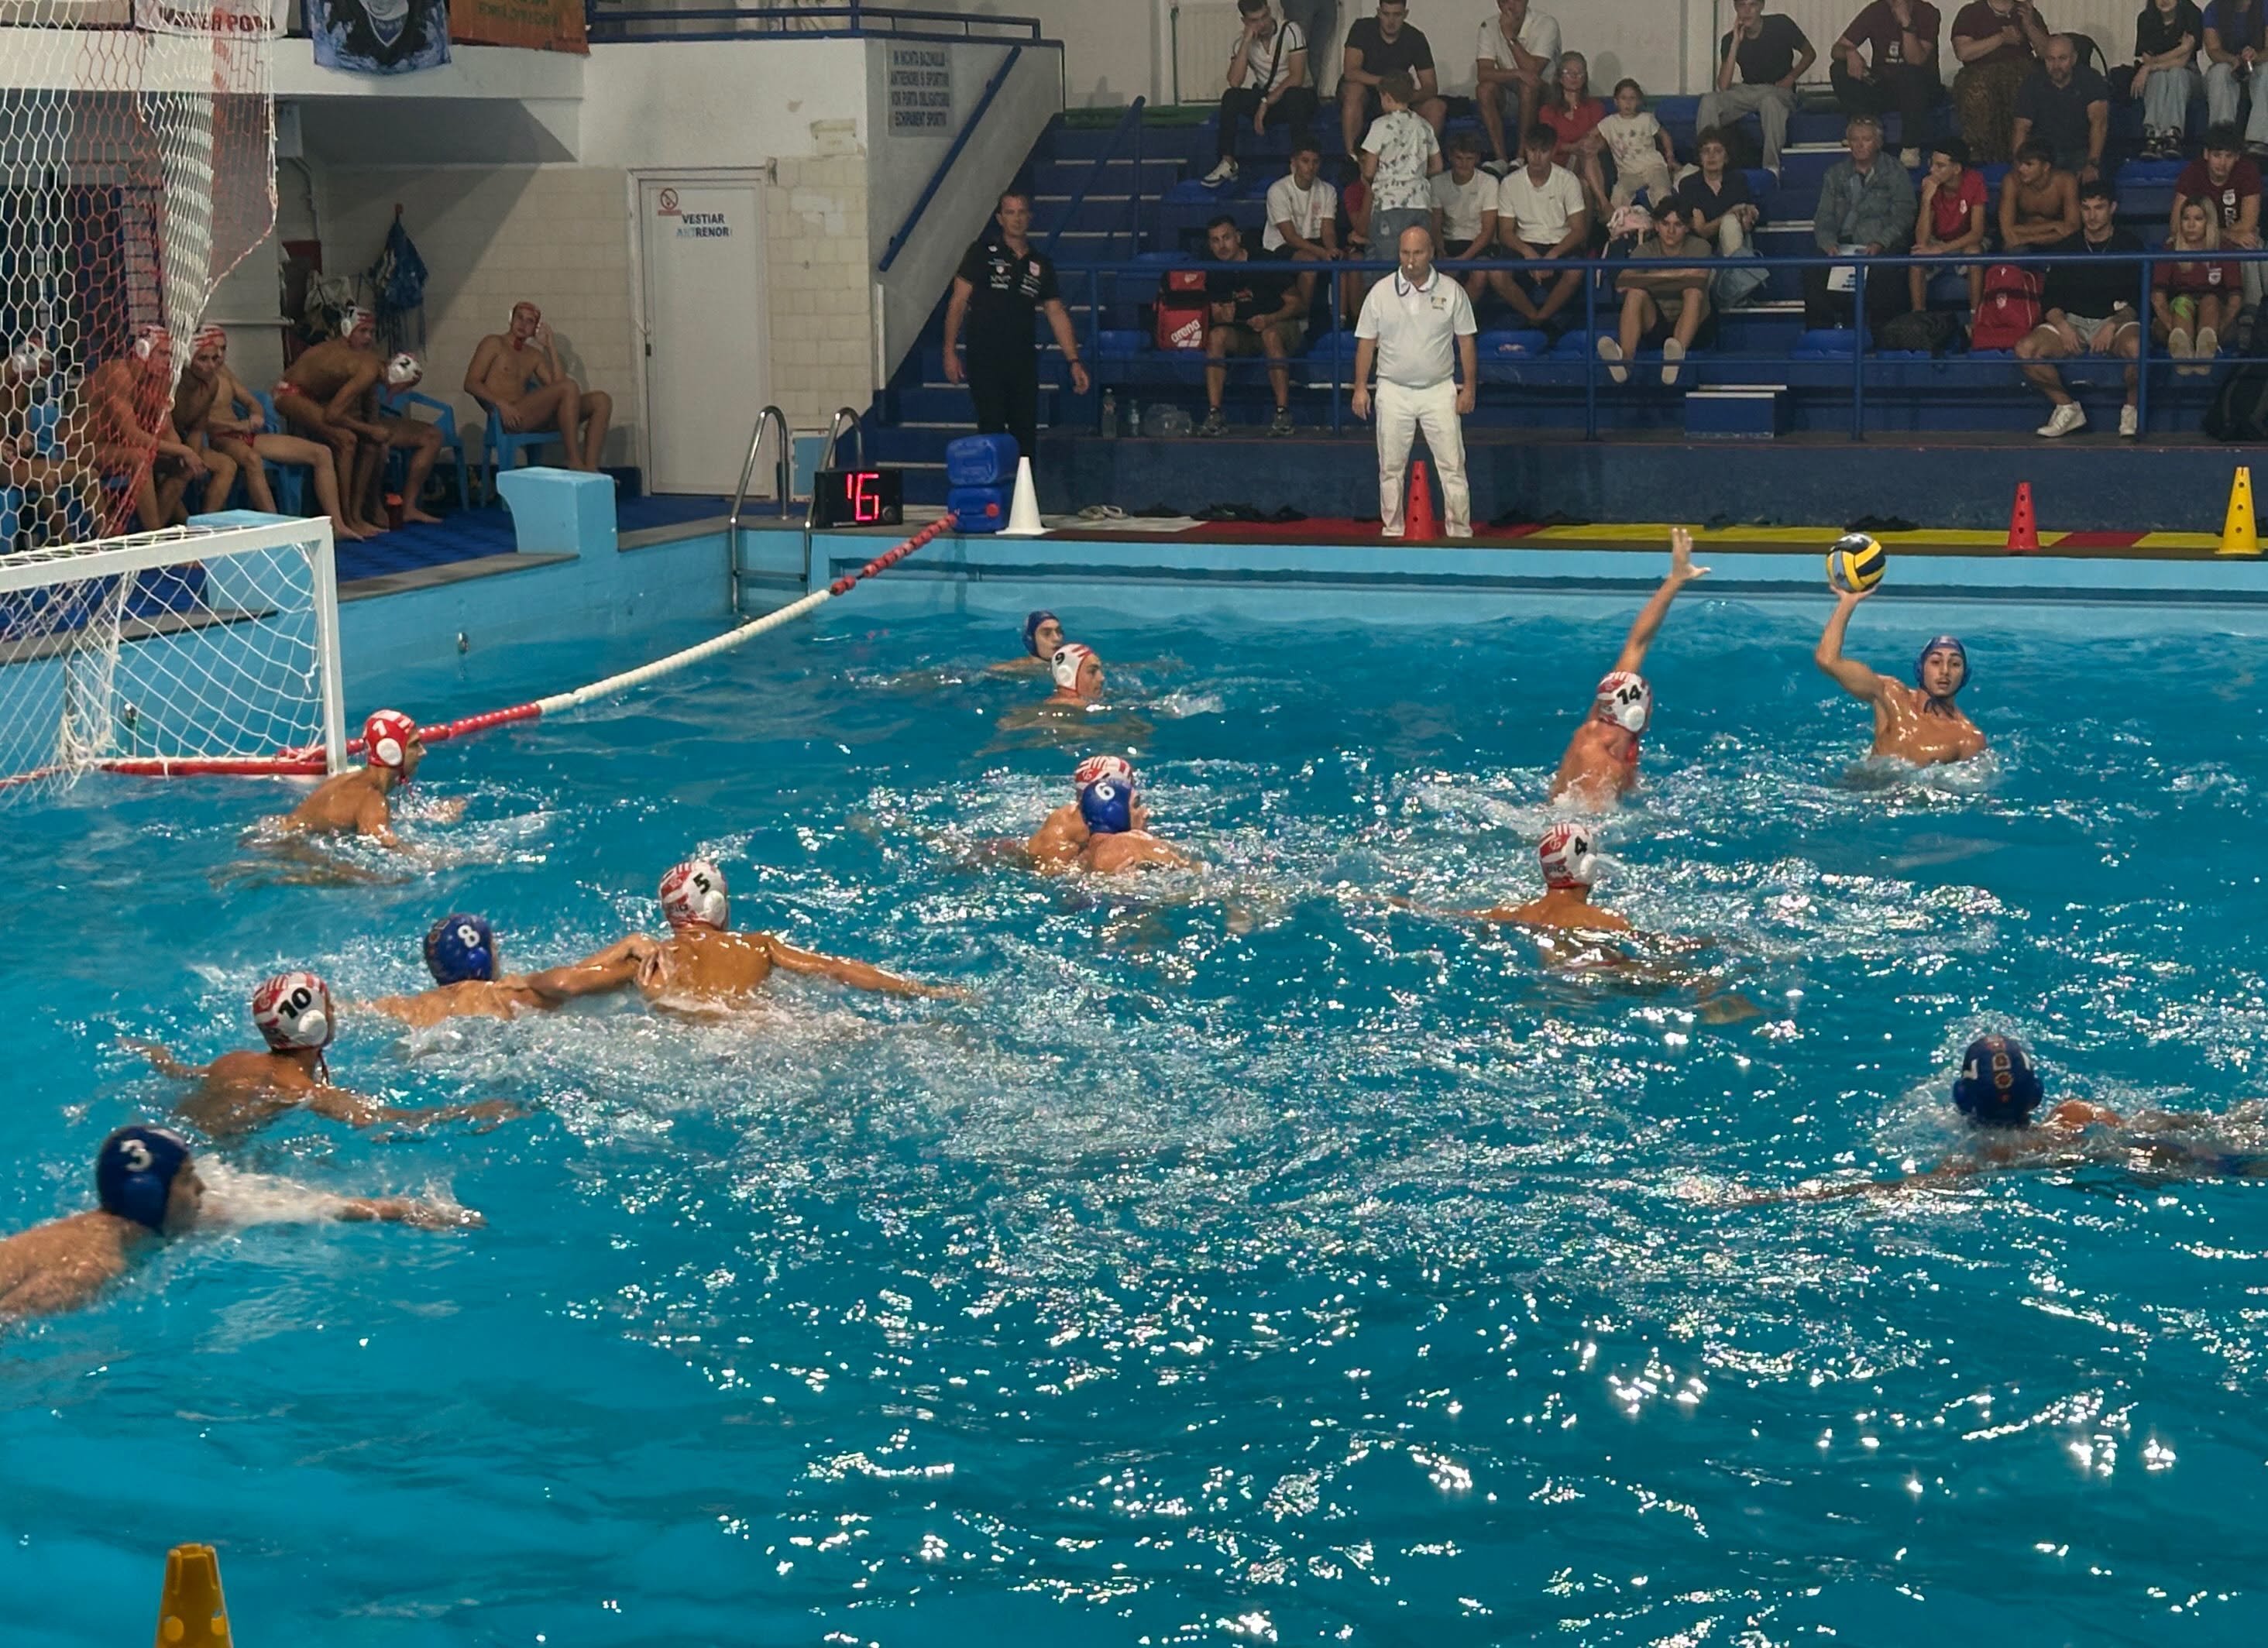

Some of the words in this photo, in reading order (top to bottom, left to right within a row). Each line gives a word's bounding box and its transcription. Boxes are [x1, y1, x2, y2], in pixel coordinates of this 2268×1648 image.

[682, 213, 725, 225] VESTIAR
[1170, 318, 1201, 343] arena
[399, 358, 411, 369] 2
[1055, 653, 1066, 665] 9
[1617, 684, 1642, 706] 14
[372, 719, 387, 737] 1
[1094, 781, 1115, 801] 6
[1574, 836, 1588, 856] 4
[692, 872, 711, 894] 5
[457, 924, 480, 949] 8
[278, 987, 311, 1019] 10
[120, 1138, 153, 1172] 3
